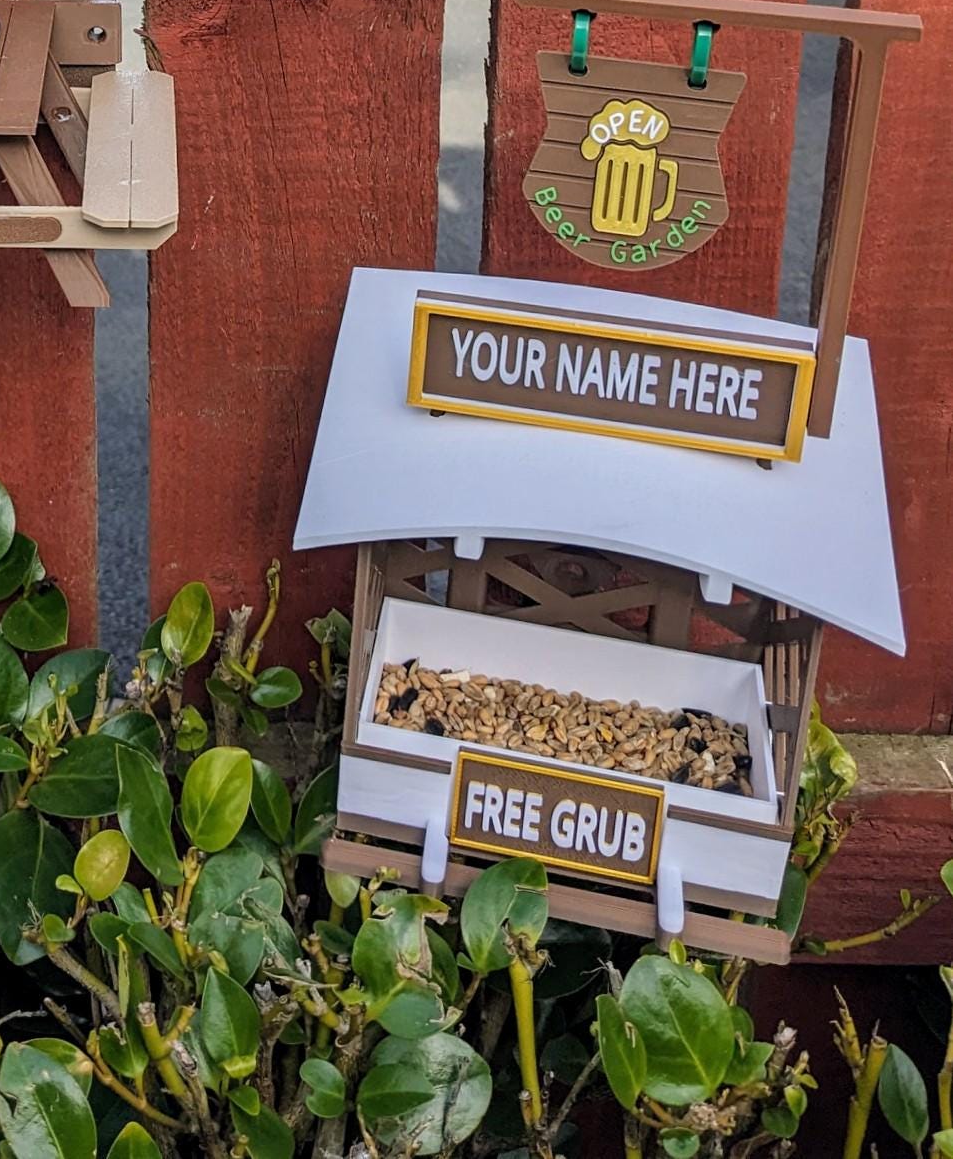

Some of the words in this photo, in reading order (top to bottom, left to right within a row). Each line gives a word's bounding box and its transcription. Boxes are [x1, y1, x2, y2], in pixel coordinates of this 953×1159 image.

[590, 110, 664, 144] OPEN
[534, 187, 591, 247] Beer
[611, 200, 712, 263] Garden
[452, 328, 546, 390] YOUR
[555, 343, 661, 406] NAME
[669, 359, 763, 420] HERE
[464, 780, 543, 842] FREE
[550, 798, 646, 862] GRUB
